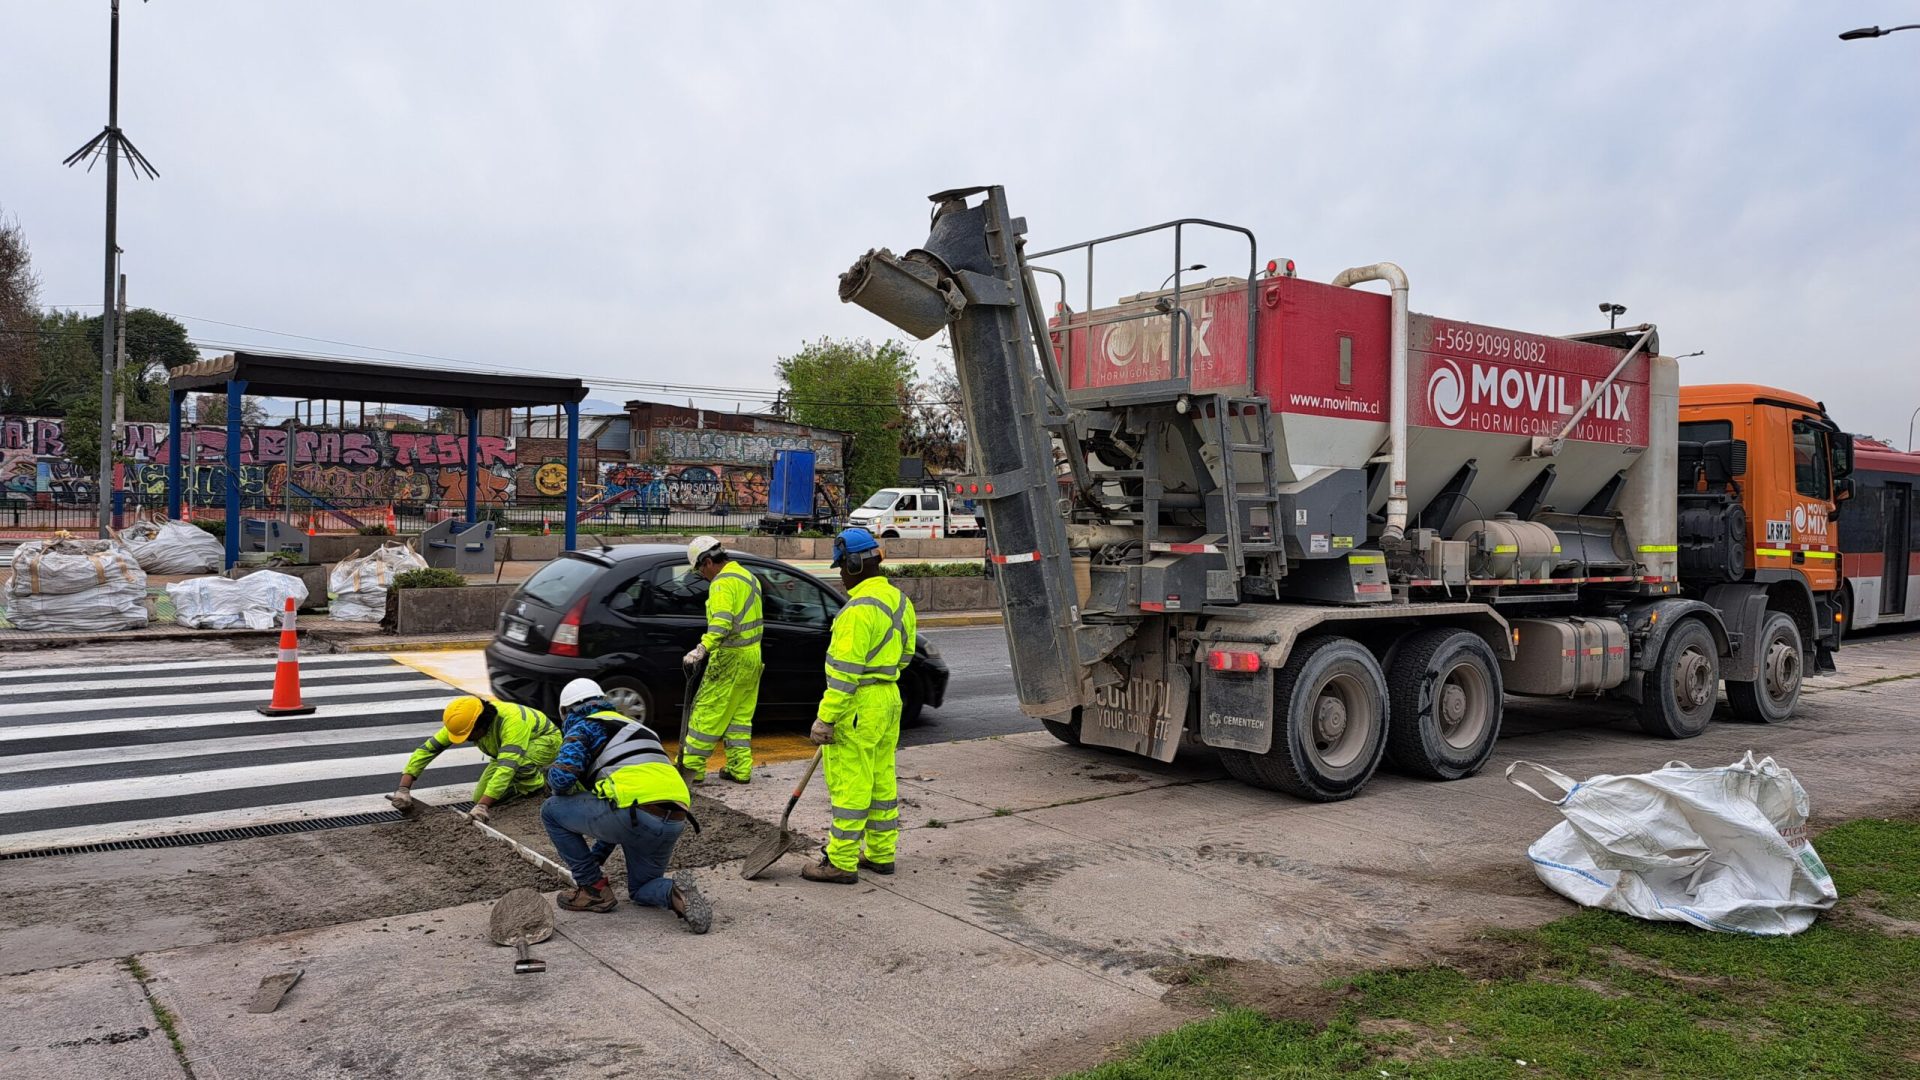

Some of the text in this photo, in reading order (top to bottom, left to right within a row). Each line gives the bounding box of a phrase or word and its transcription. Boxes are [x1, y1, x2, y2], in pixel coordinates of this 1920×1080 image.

[1435, 328, 1546, 363] +569 9099 8082
[1290, 393, 1380, 414] www.movilmix.cl
[1471, 363, 1631, 422] MOVIL MIX
[1576, 420, 1632, 444] MÓVILES
[1807, 514, 1828, 535] MIX
[1097, 708, 1170, 741] YOUR CONCETE
[1223, 715, 1265, 730] CEMENTECH
